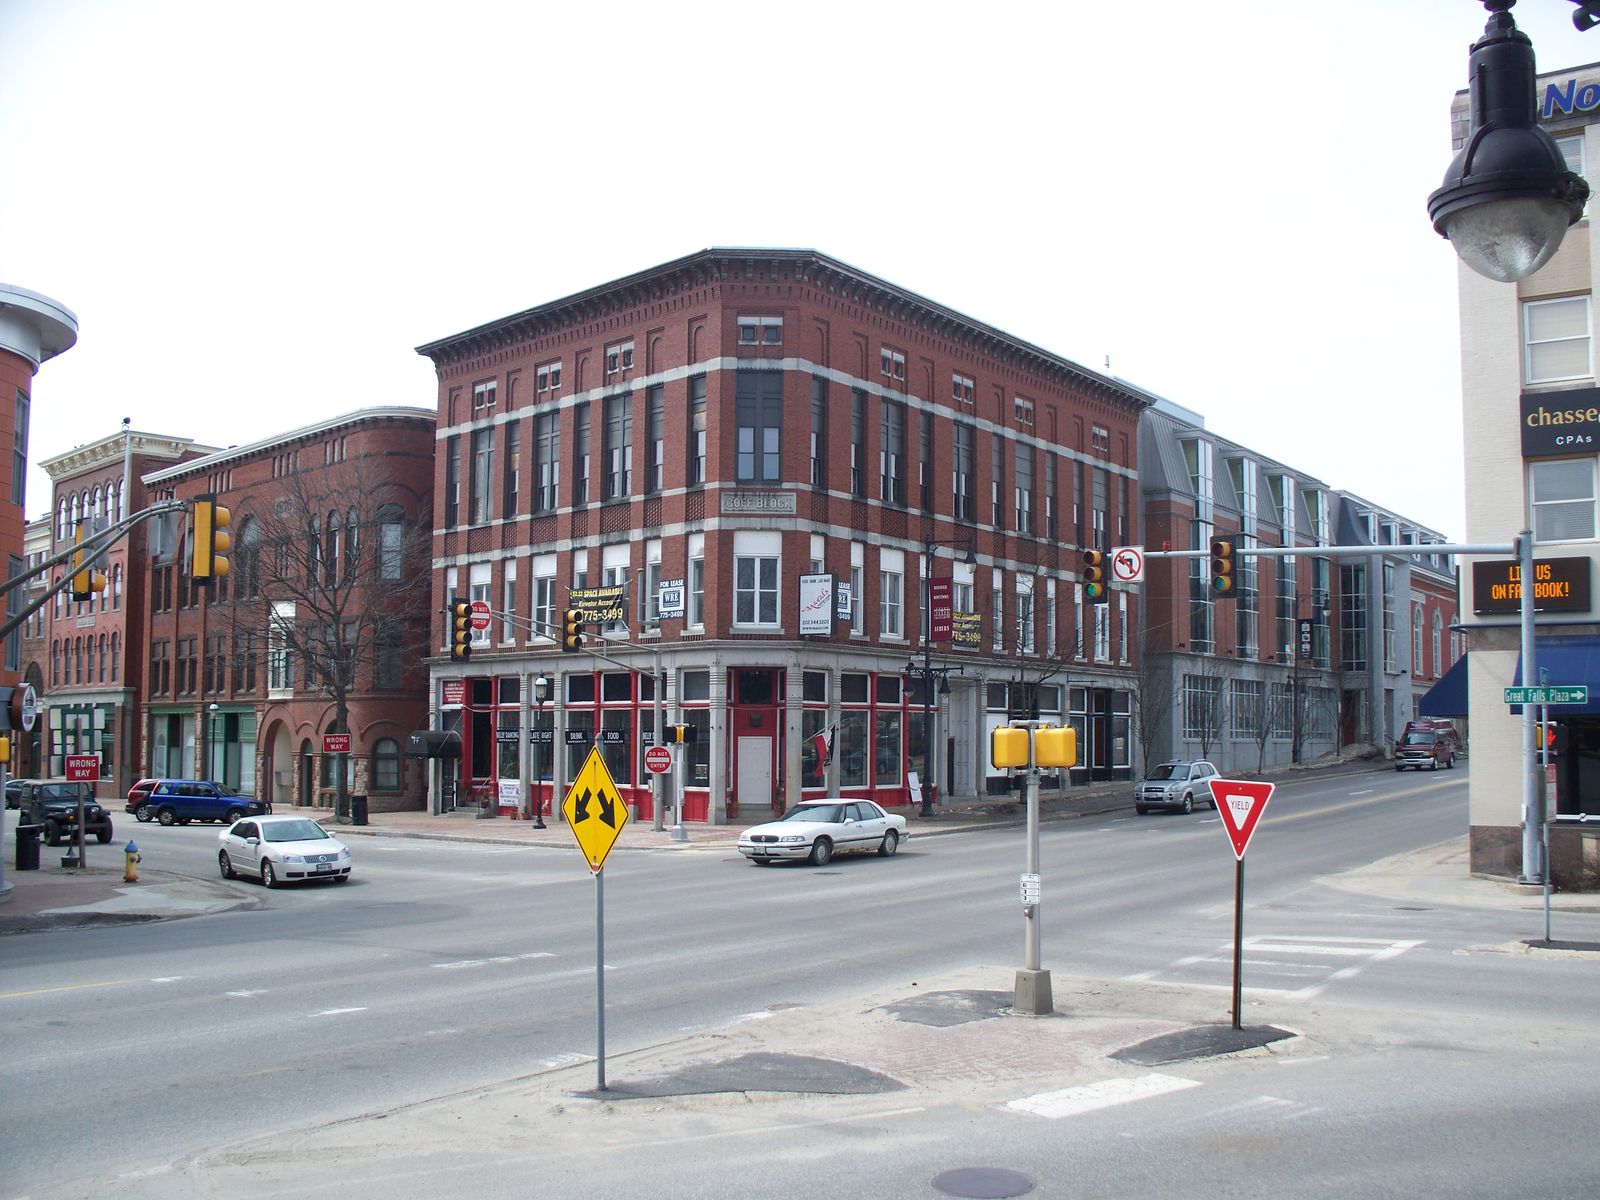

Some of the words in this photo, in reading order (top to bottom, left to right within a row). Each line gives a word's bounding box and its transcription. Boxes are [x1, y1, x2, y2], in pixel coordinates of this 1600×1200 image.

[1527, 406, 1598, 426] chasse
[1555, 434, 1592, 445] CPAs
[726, 496, 752, 508] GOFF
[756, 497, 791, 508] BLOCK
[1536, 564, 1552, 580] US
[660, 580, 669, 588] FOR
[670, 579, 684, 587] LEASE
[839, 582, 851, 590] LEASE
[1491, 584, 1506, 599] ON
[1508, 581, 1569, 599] FABOOK!
[664, 592, 679, 602] WRE
[583, 607, 623, 621] 775-3499
[1504, 689, 1525, 702] Great
[1528, 689, 1546, 702] Falls
[1549, 689, 1570, 702] Plaza
[607, 732, 620, 740] FOOD
[69, 759, 96, 768] WRONG
[75, 769, 91, 777] WAY
[1231, 800, 1250, 811] YIELD
